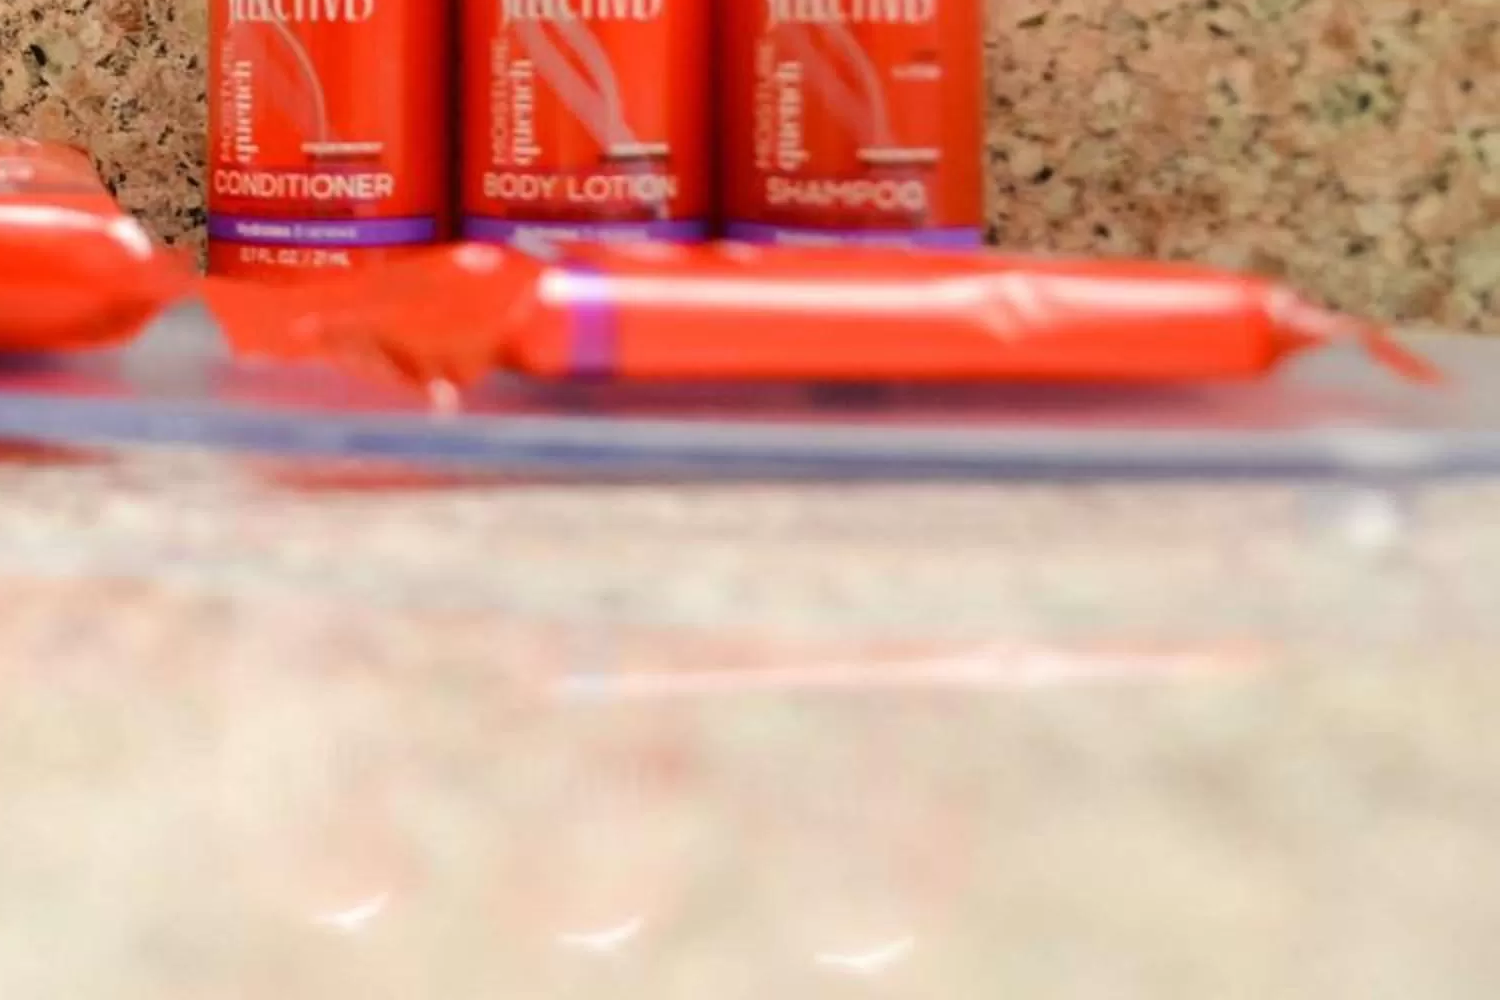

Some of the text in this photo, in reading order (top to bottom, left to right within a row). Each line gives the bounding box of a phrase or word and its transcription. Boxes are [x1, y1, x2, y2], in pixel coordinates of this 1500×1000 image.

[213, 168, 397, 199] CONDITIONER
[484, 172, 679, 202] BODY LOTION
[765, 175, 928, 211] SHAMPOO
